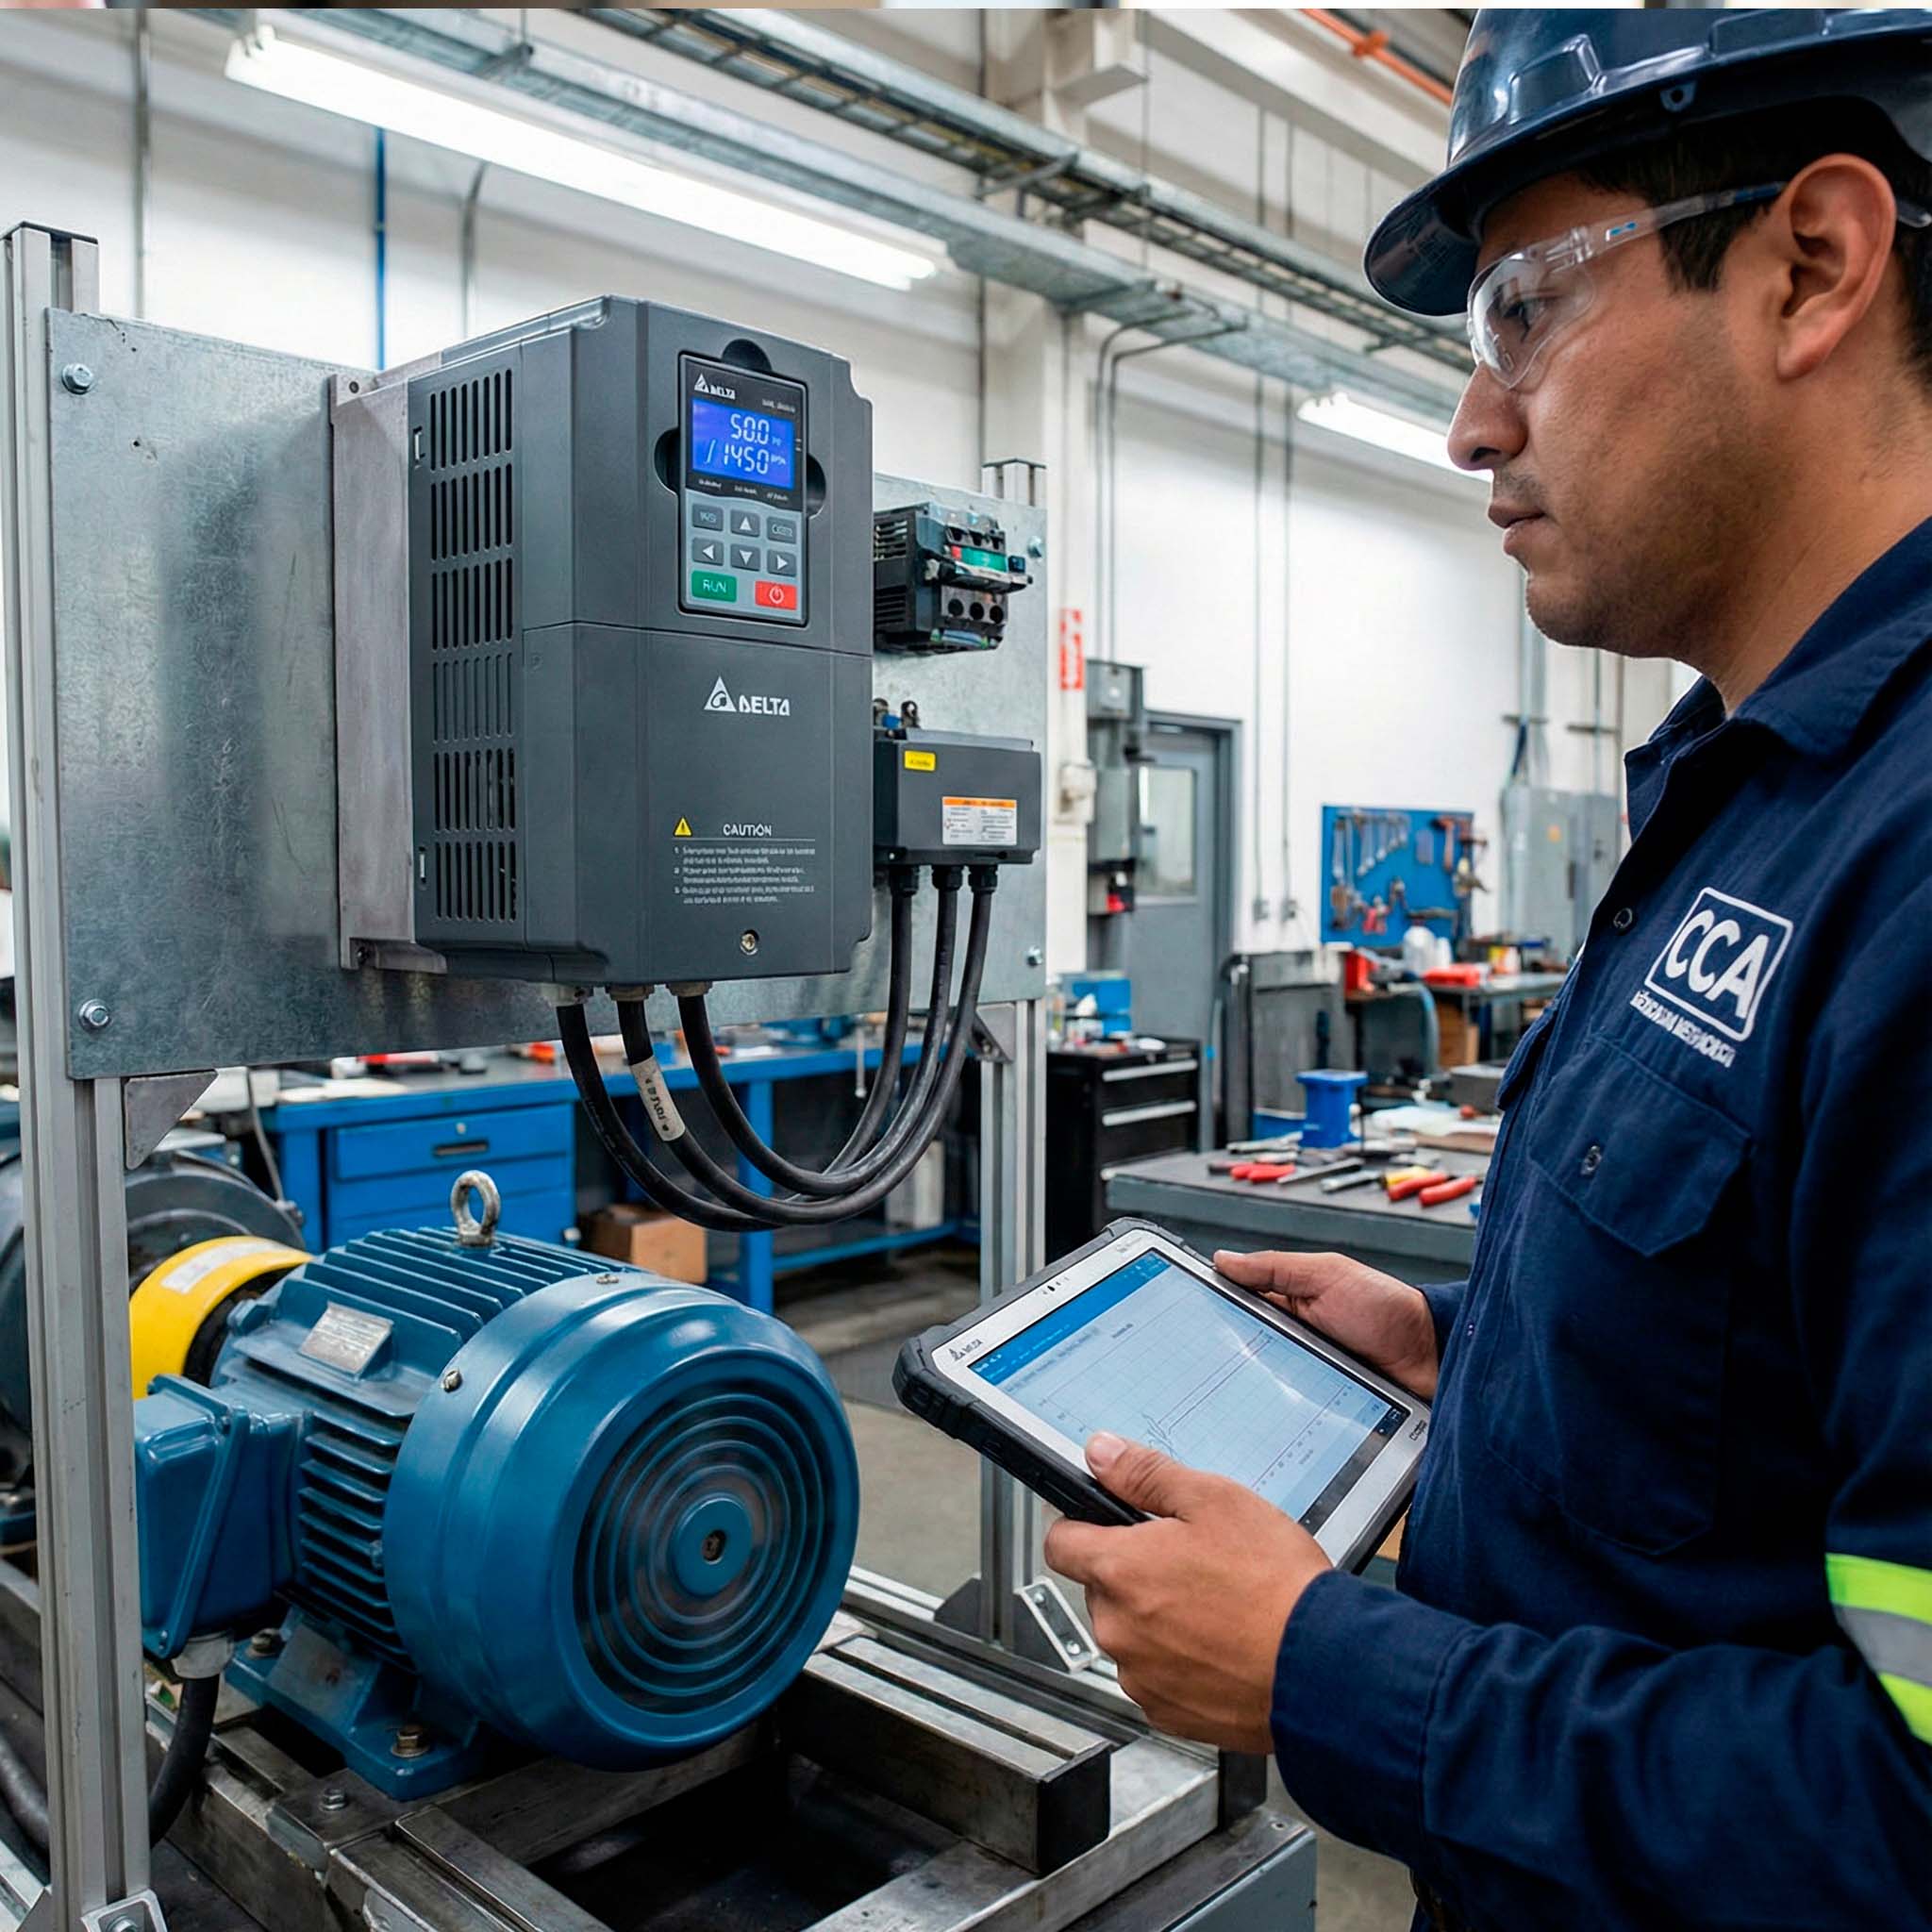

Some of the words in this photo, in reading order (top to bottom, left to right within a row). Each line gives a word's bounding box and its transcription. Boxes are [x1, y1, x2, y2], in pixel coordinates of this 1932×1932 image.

[724, 443, 770, 475] 1450
[702, 579, 726, 593] RUN
[738, 694, 791, 716] DELTA
[723, 823, 773, 837] CAUTION
[1665, 909, 1769, 1019] CCA
